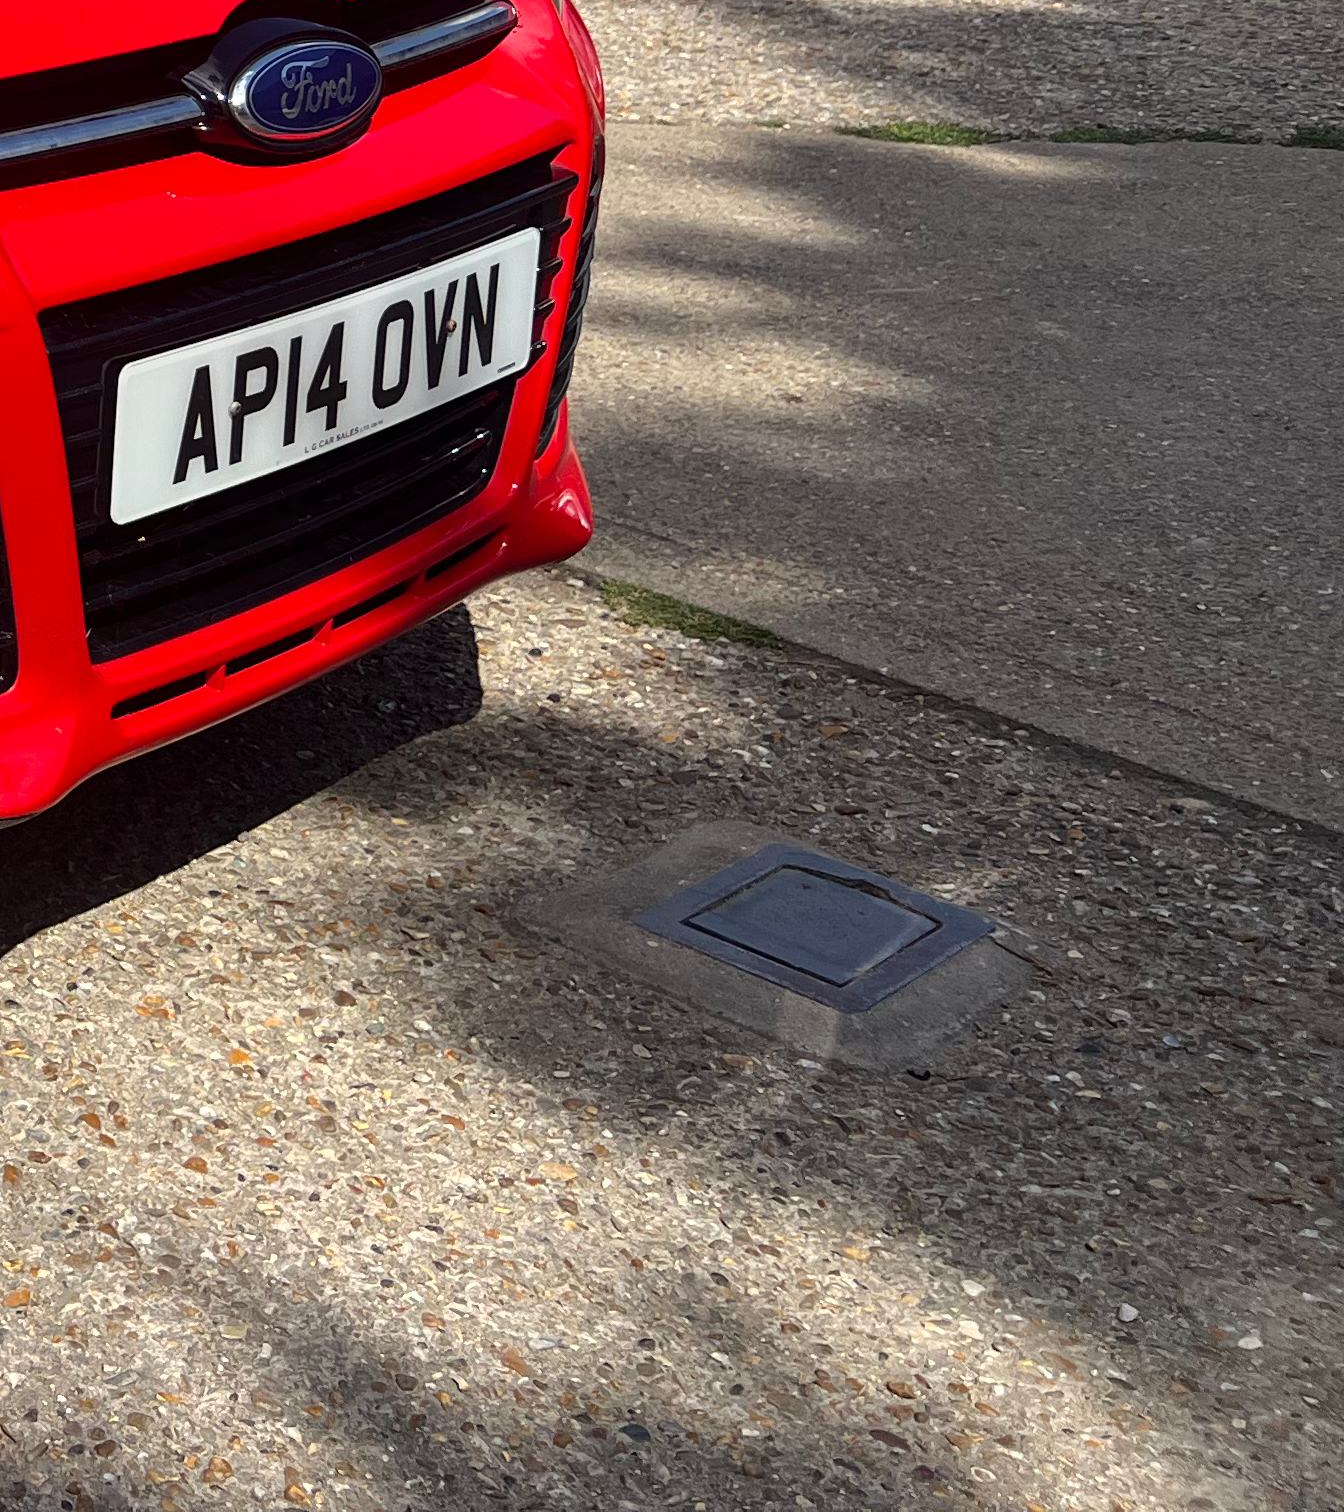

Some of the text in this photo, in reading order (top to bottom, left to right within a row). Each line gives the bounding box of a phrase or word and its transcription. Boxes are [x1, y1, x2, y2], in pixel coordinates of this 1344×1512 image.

[280, 55, 357, 120] Ford
[172, 262, 501, 485] AP14 OVN
[318, 436, 335, 448] CAR
[336, 426, 360, 442] SALES
